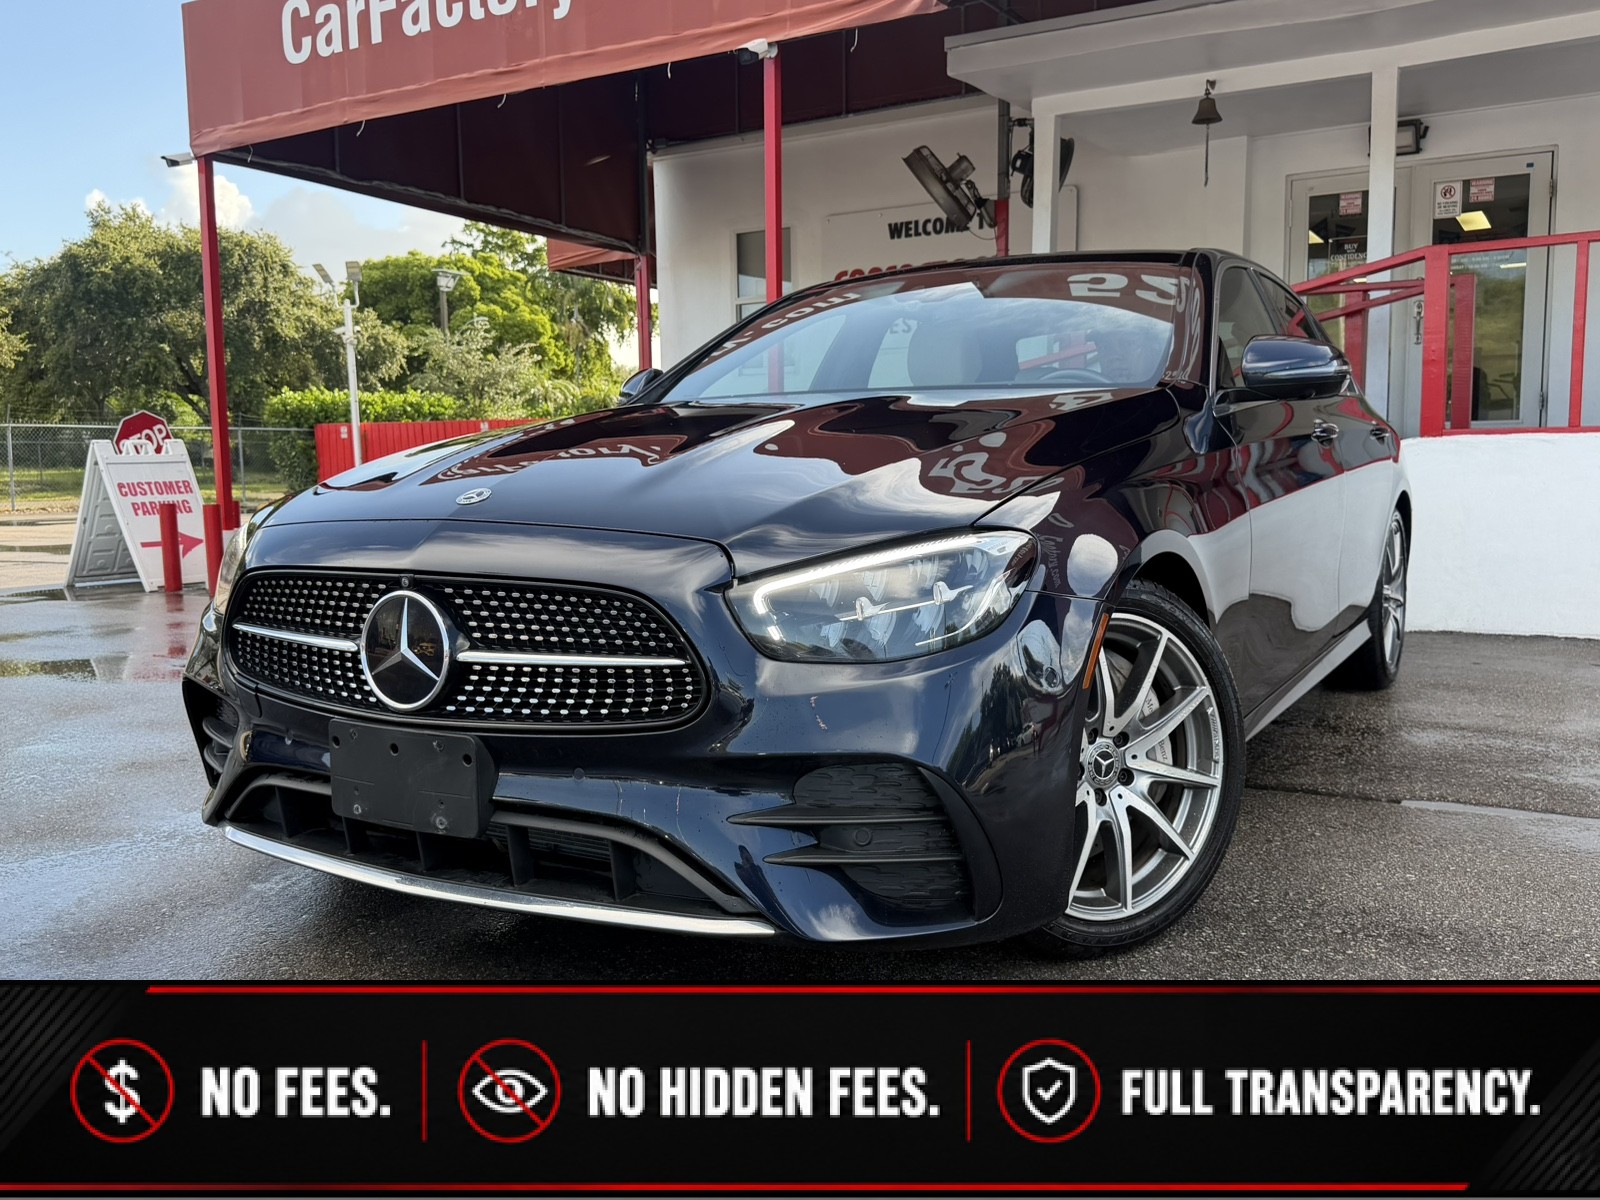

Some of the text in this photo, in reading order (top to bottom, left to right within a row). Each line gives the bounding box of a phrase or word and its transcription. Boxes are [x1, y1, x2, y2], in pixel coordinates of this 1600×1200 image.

[888, 216, 970, 240] WELCOM
[117, 480, 194, 497] CUSTOMER
[131, 500, 193, 516] PARNG
